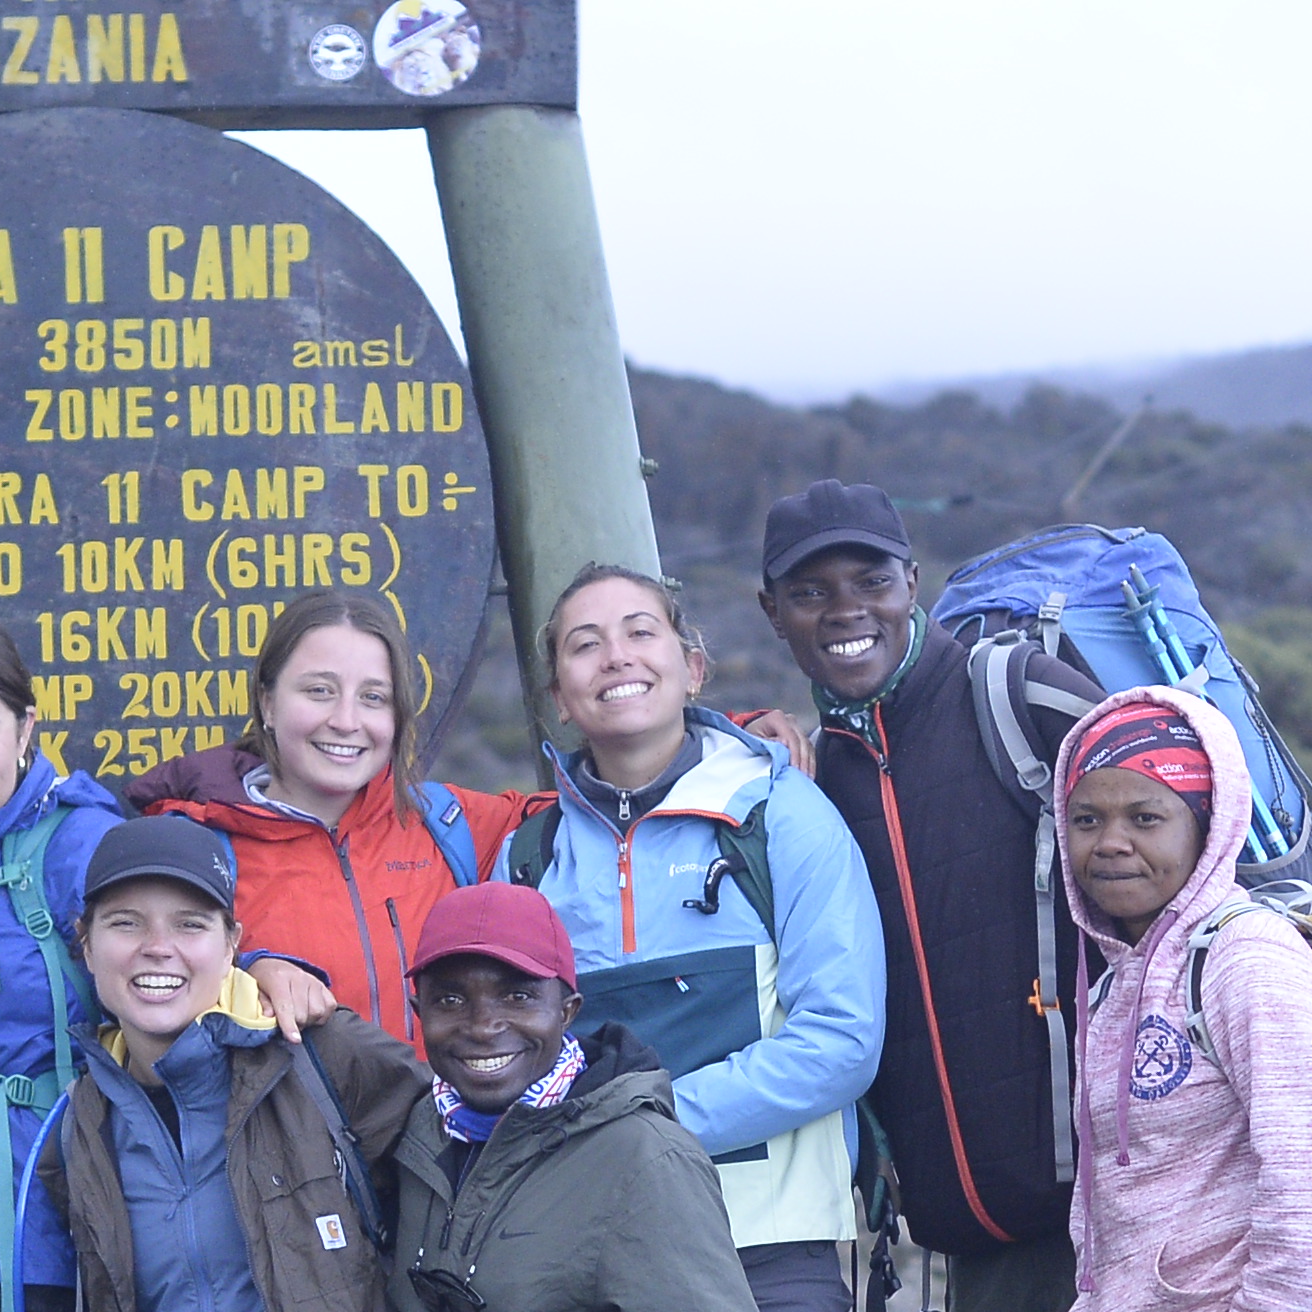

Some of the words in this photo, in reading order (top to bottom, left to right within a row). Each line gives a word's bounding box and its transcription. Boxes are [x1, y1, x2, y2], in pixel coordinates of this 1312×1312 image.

[149, 224, 309, 301] CAMP
[38, 317, 211, 372] 3850M
[293, 326, 413, 368] amsl
[182, 466, 325, 521] CAMP
[58, 537, 185, 592] 10KM
[206, 525, 401, 598] (6HRS)
[37, 607, 168, 662] 16KM
[120, 670, 250, 718] 20KM
